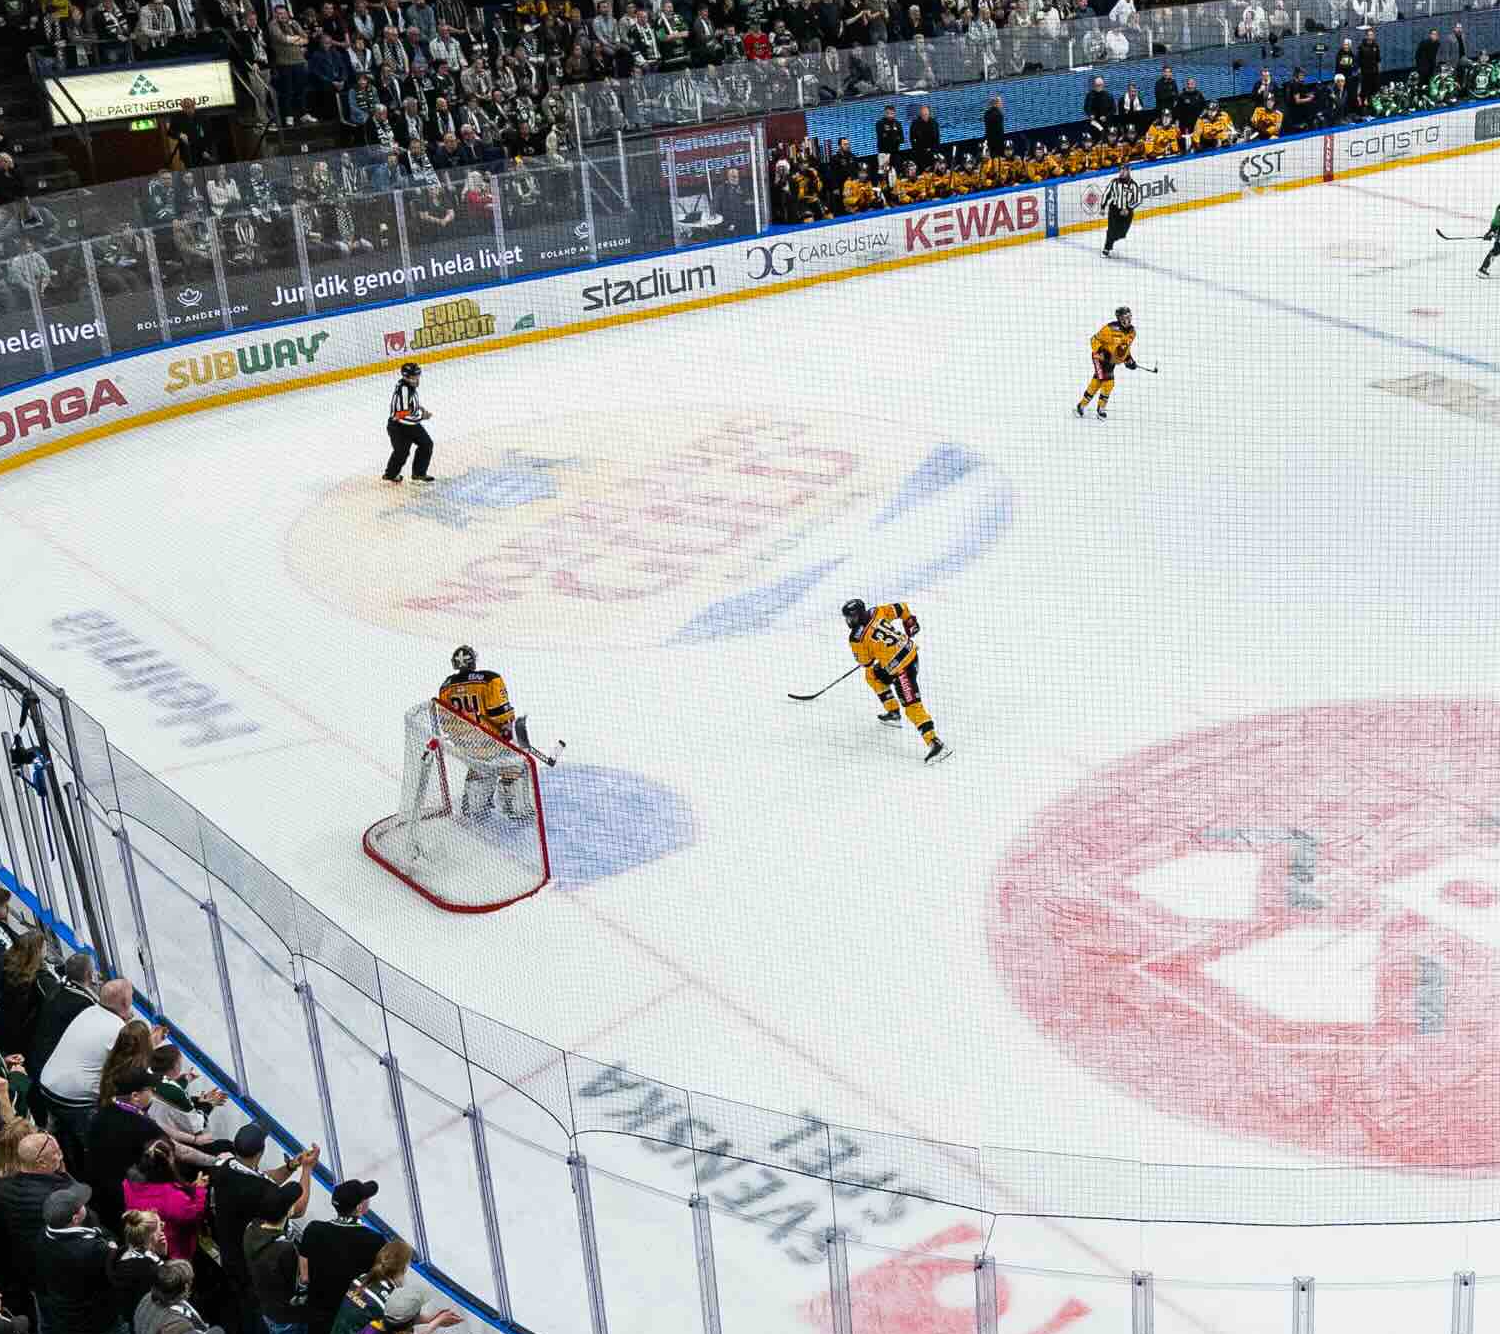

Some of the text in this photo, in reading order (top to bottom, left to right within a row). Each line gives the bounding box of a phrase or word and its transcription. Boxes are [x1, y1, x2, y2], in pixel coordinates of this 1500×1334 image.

[905, 195, 1040, 253] KEWAB
[271, 276, 348, 308] Jurdik
[431, 253, 477, 280] hela
[479, 244, 525, 271] livet
[581, 263, 717, 313] stadium
[49, 316, 107, 348] livet
[136, 312, 182, 332] ROLND
[164, 329, 331, 395] SUBWAY
